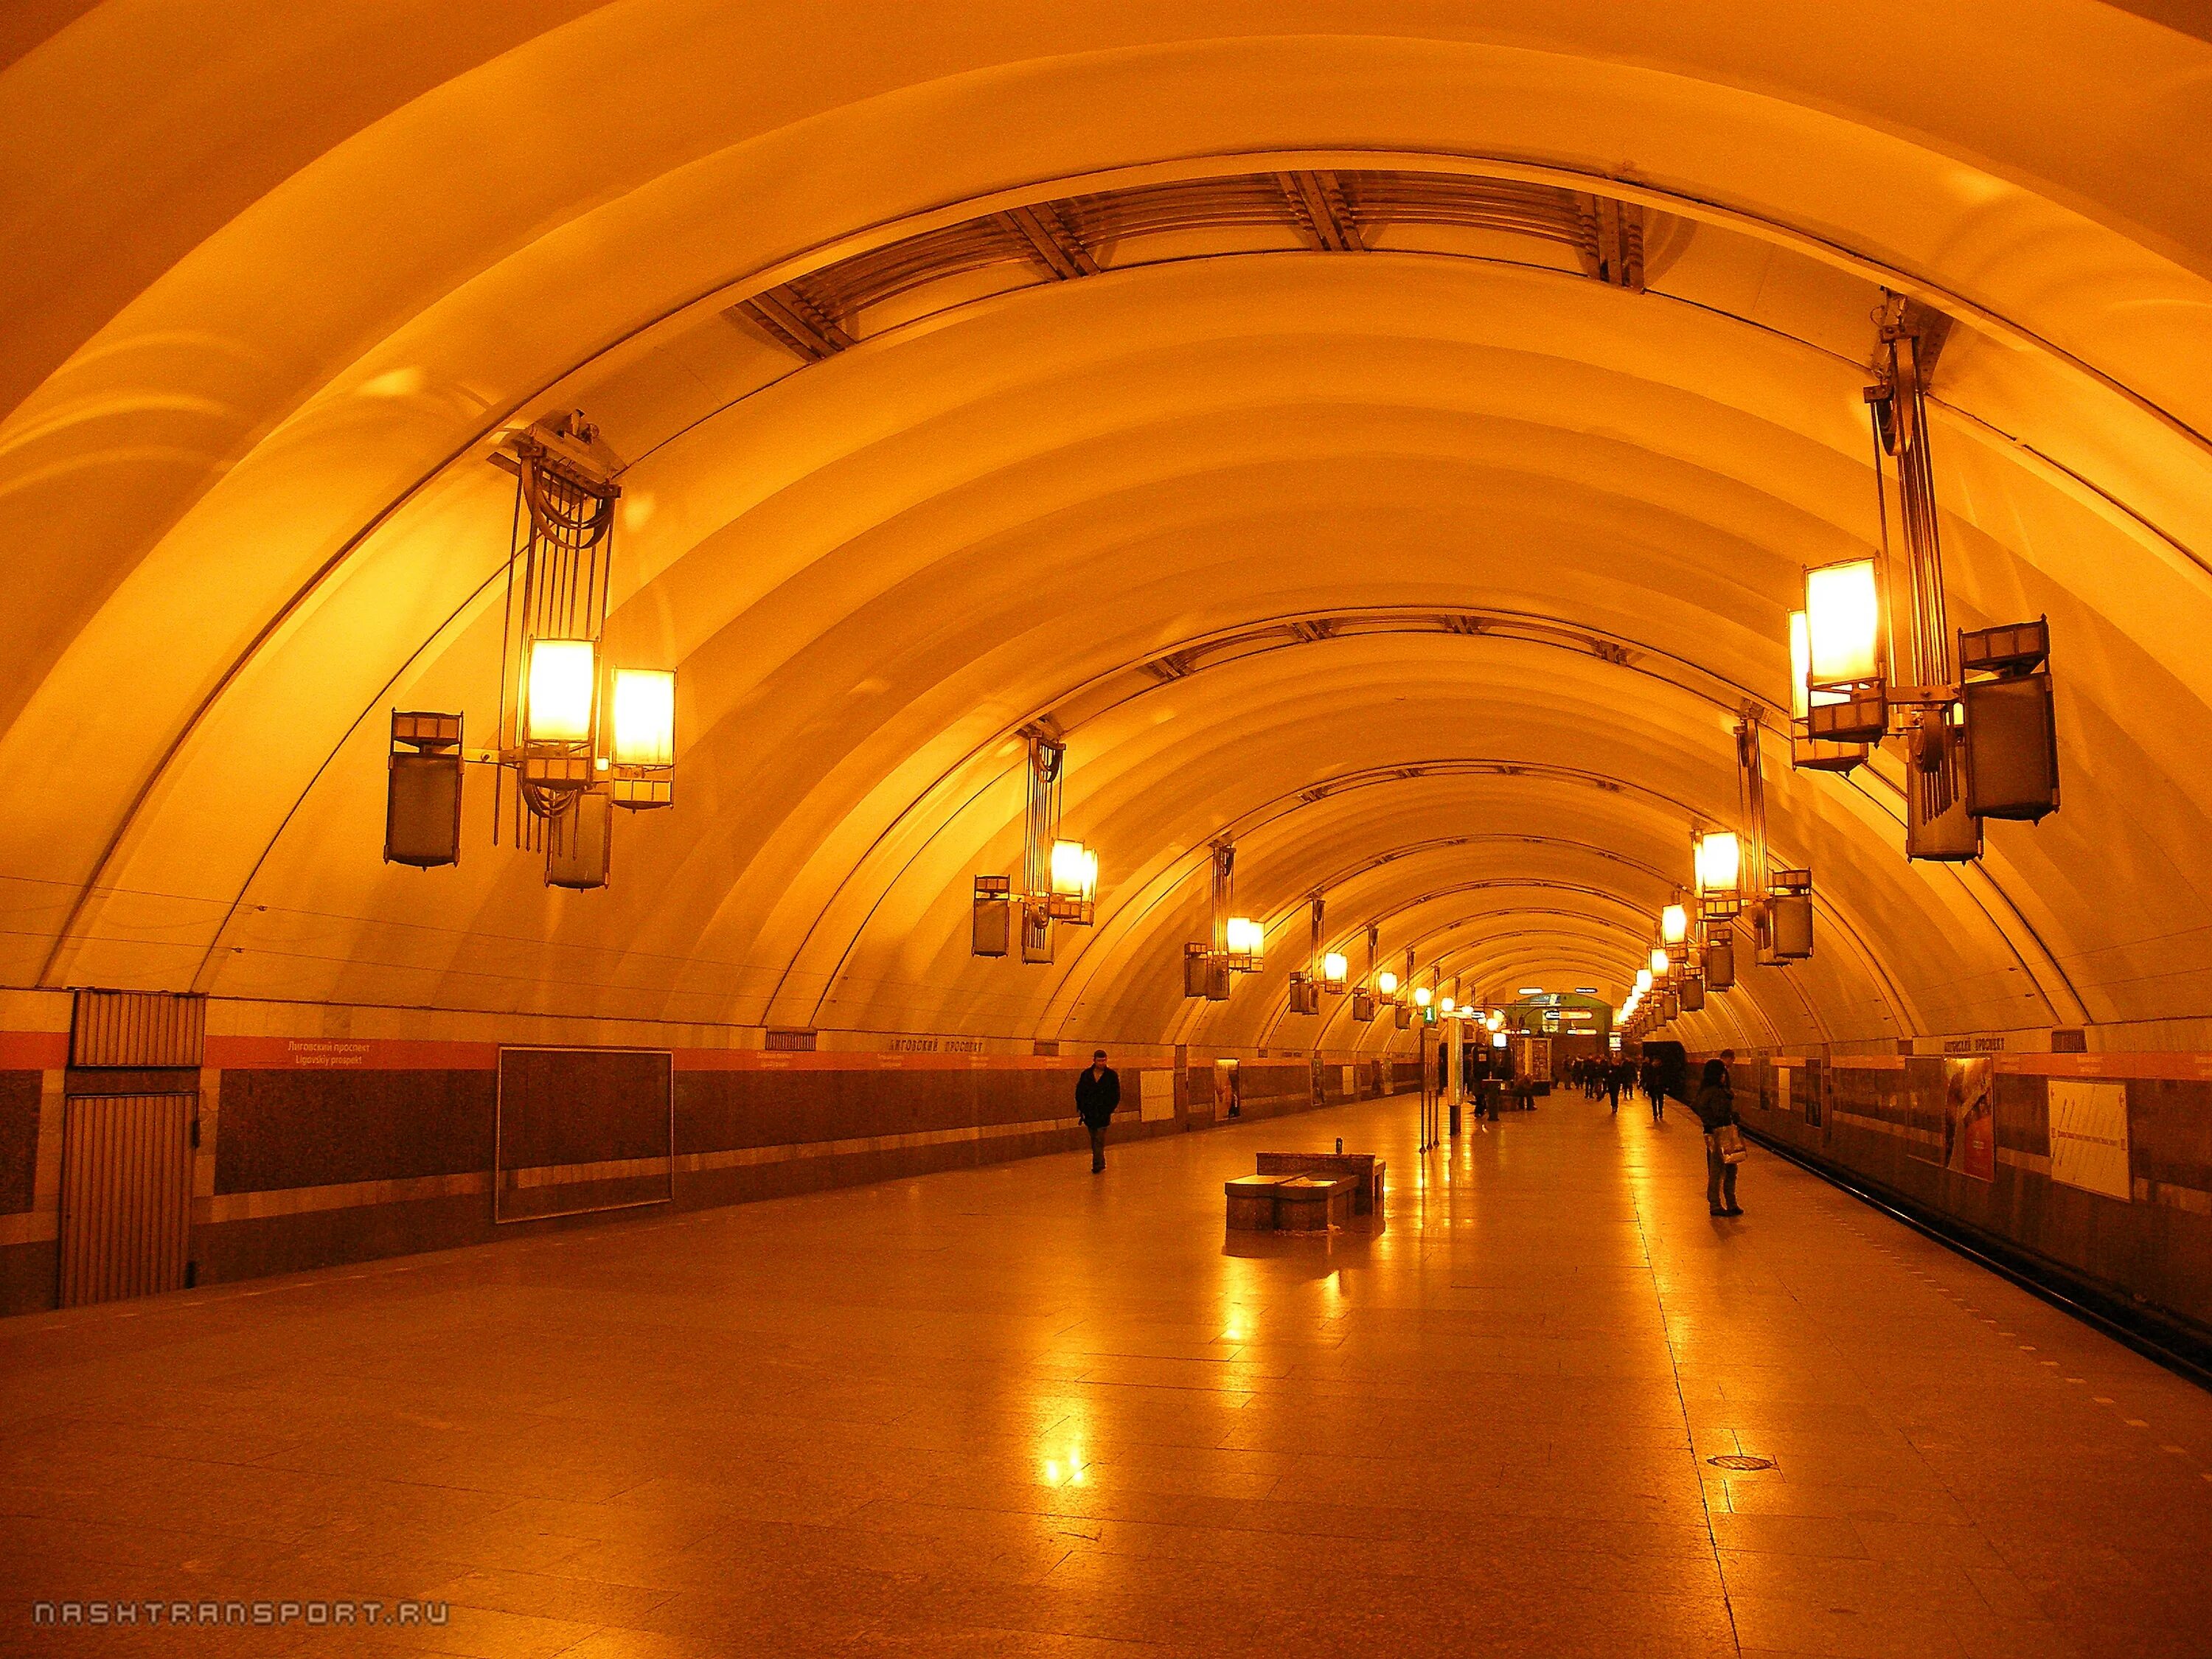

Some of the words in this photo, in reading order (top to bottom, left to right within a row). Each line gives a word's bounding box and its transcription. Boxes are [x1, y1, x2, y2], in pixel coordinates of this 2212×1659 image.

[288, 1041, 333, 1051] Лиговский
[334, 1043, 370, 1053] проспект
[296, 1055, 330, 1065] Ligovskiy
[331, 1055, 362, 1065] prospekt
